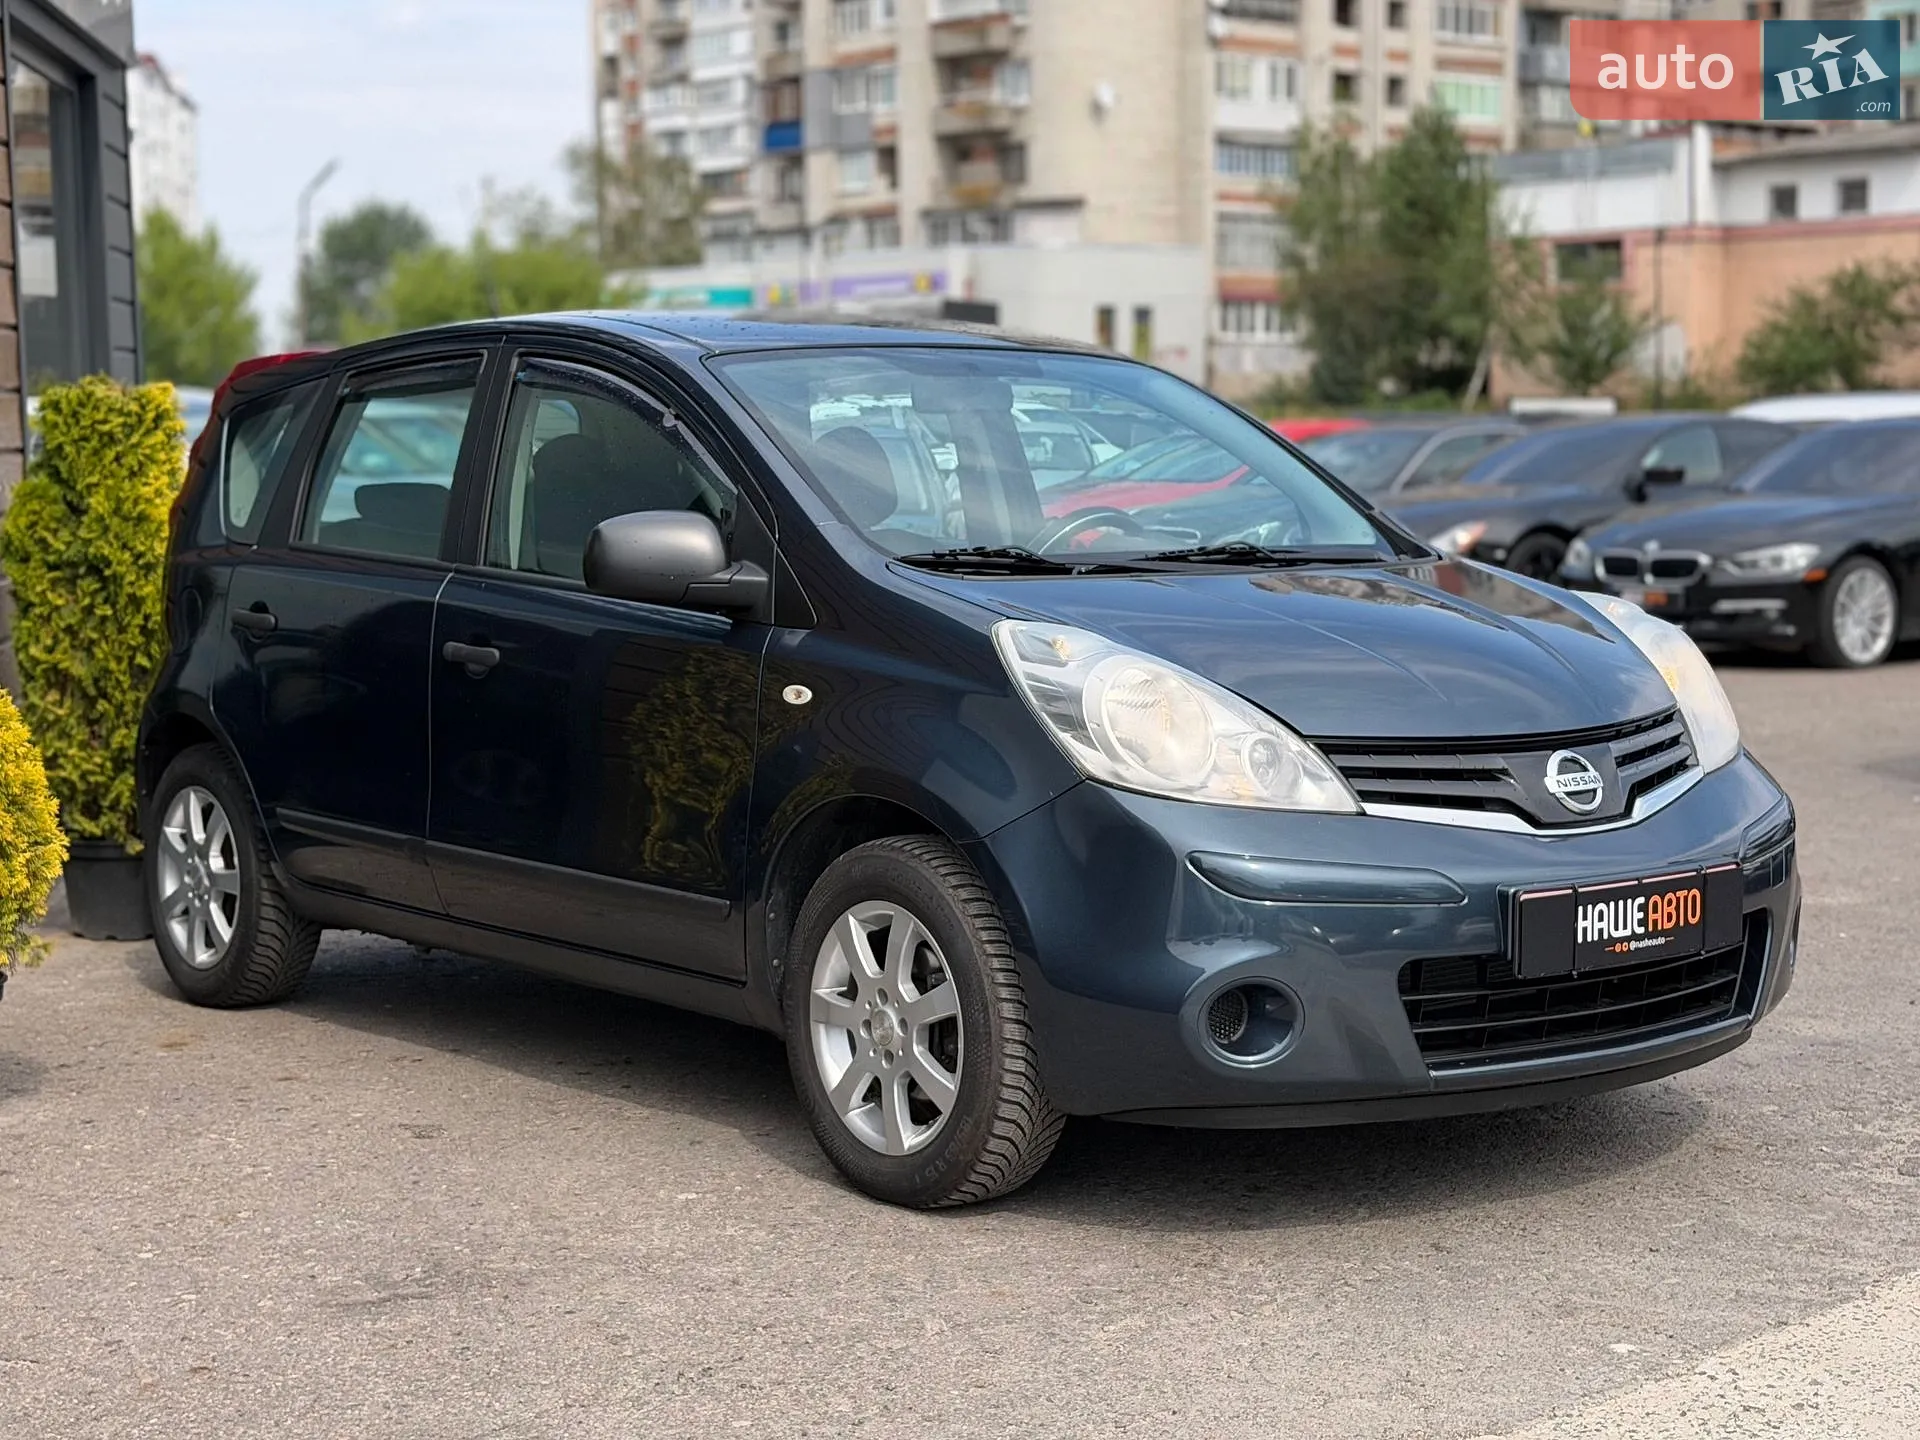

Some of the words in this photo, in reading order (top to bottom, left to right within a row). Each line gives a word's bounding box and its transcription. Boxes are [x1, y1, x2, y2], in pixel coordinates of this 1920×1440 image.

[1556, 774, 1602, 788] NISSAN
[1577, 896, 1646, 944] НАШЕ
[1648, 888, 1701, 932] АВТО
